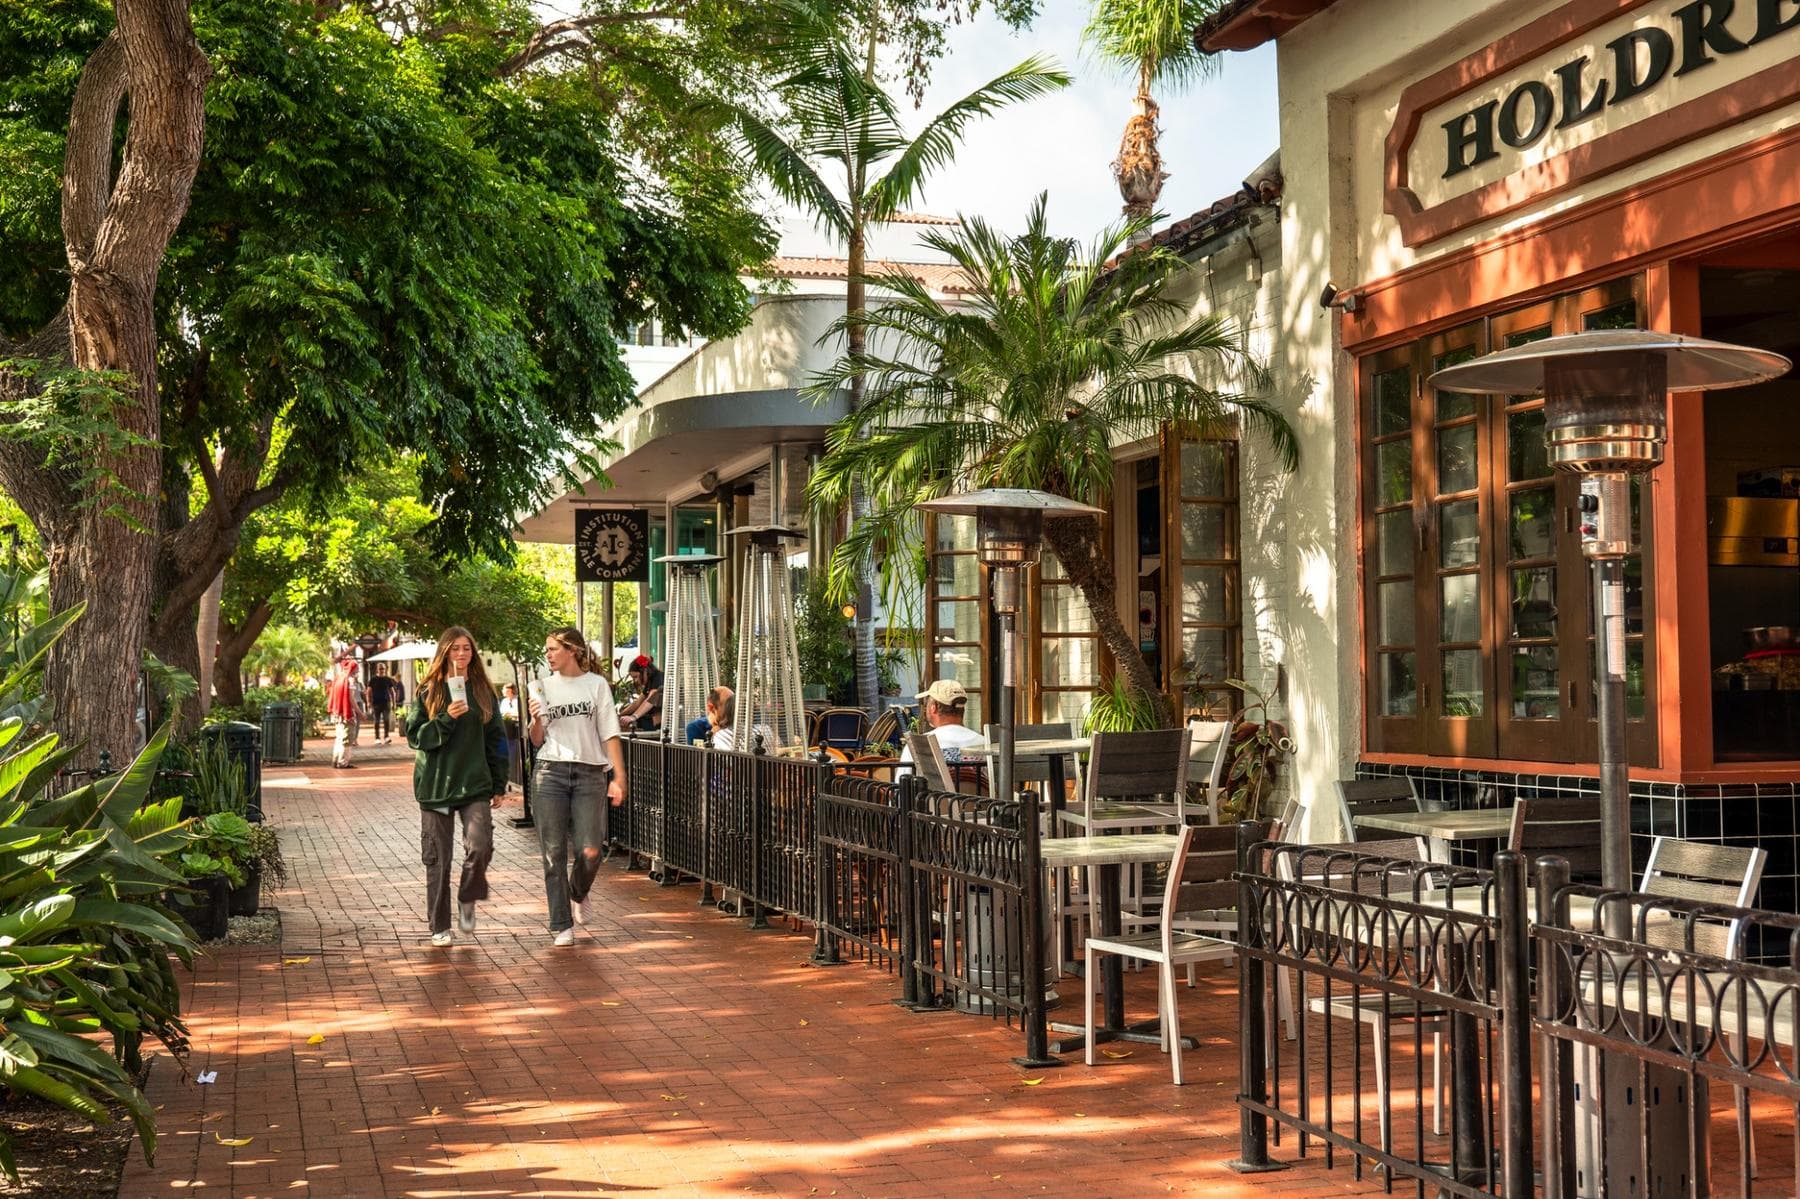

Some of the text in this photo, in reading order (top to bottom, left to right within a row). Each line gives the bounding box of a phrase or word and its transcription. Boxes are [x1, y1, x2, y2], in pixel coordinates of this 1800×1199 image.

[581, 513, 644, 539] INSTITUTION
[580, 549, 644, 578] ALE COMPANY
